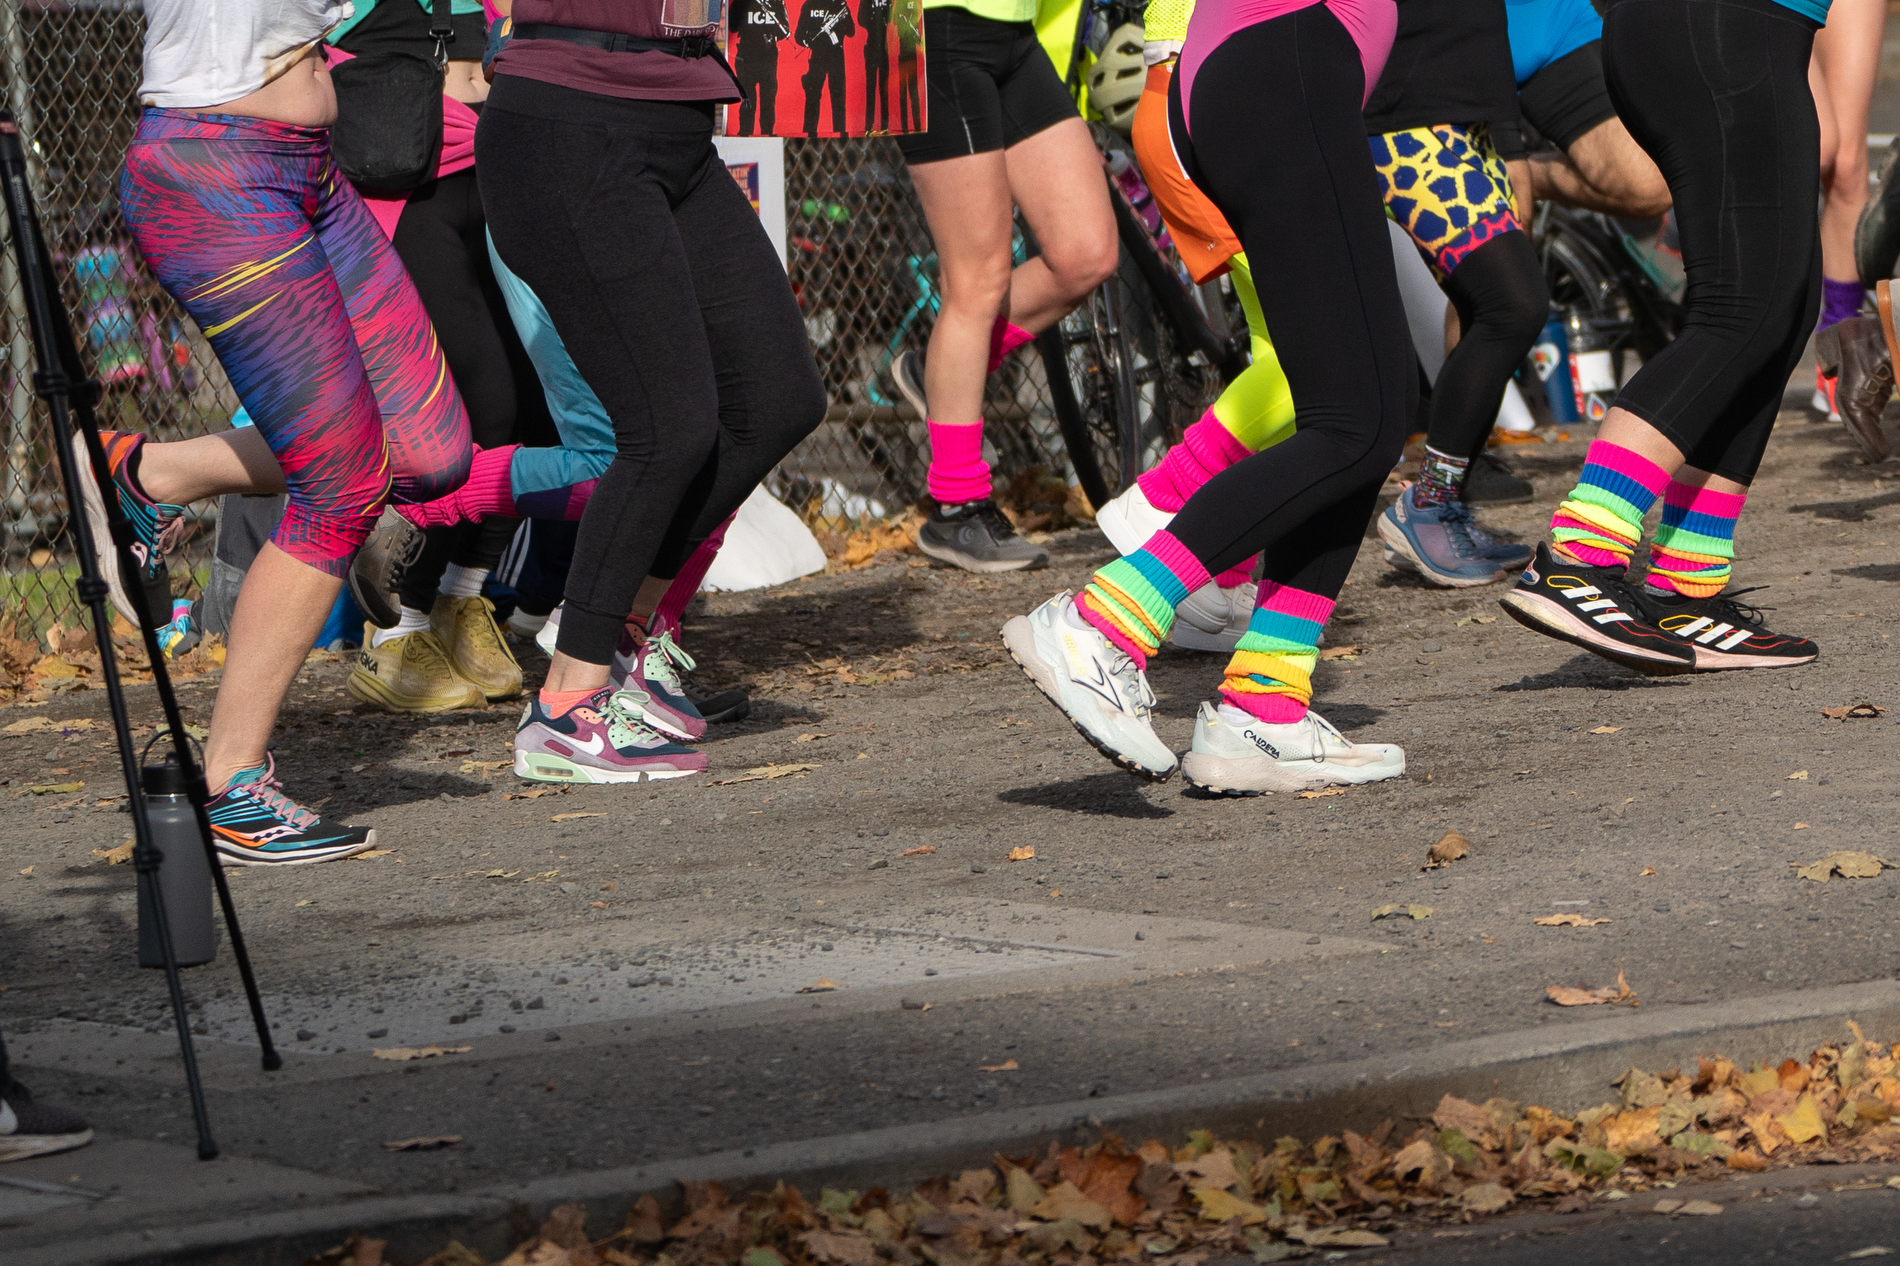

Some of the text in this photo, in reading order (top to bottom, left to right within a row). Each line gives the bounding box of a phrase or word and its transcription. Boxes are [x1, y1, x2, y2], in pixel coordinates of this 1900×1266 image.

[747, 11, 777, 25] ICE
[810, 9, 824, 18] ICE
[663, 27, 683, 38] THE
[360, 649, 378, 676] OKA
[1243, 729, 1280, 758] CALDERA
